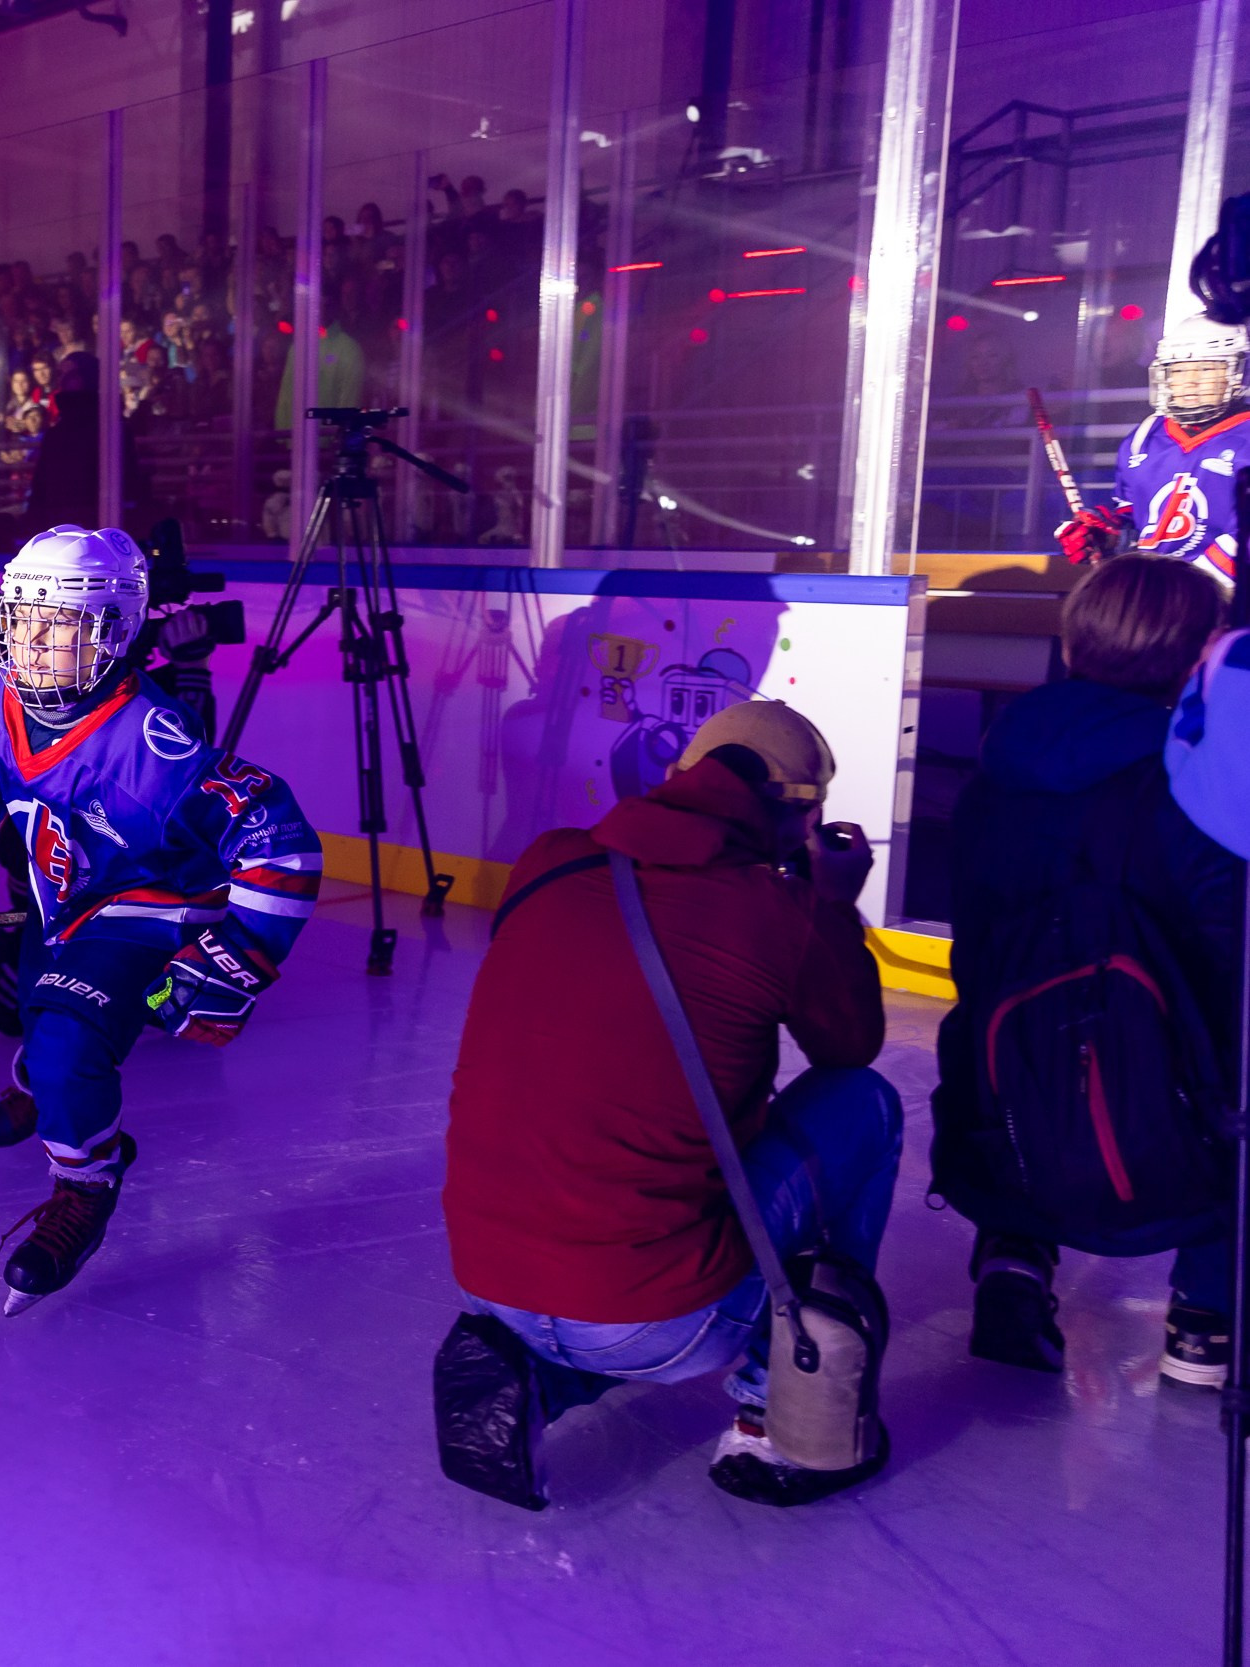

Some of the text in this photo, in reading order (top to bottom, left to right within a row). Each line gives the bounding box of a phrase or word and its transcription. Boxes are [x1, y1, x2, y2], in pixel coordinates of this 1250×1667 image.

[12, 571, 53, 582] BAUER
[613, 644, 627, 673] 1
[200, 750, 273, 818] 15
